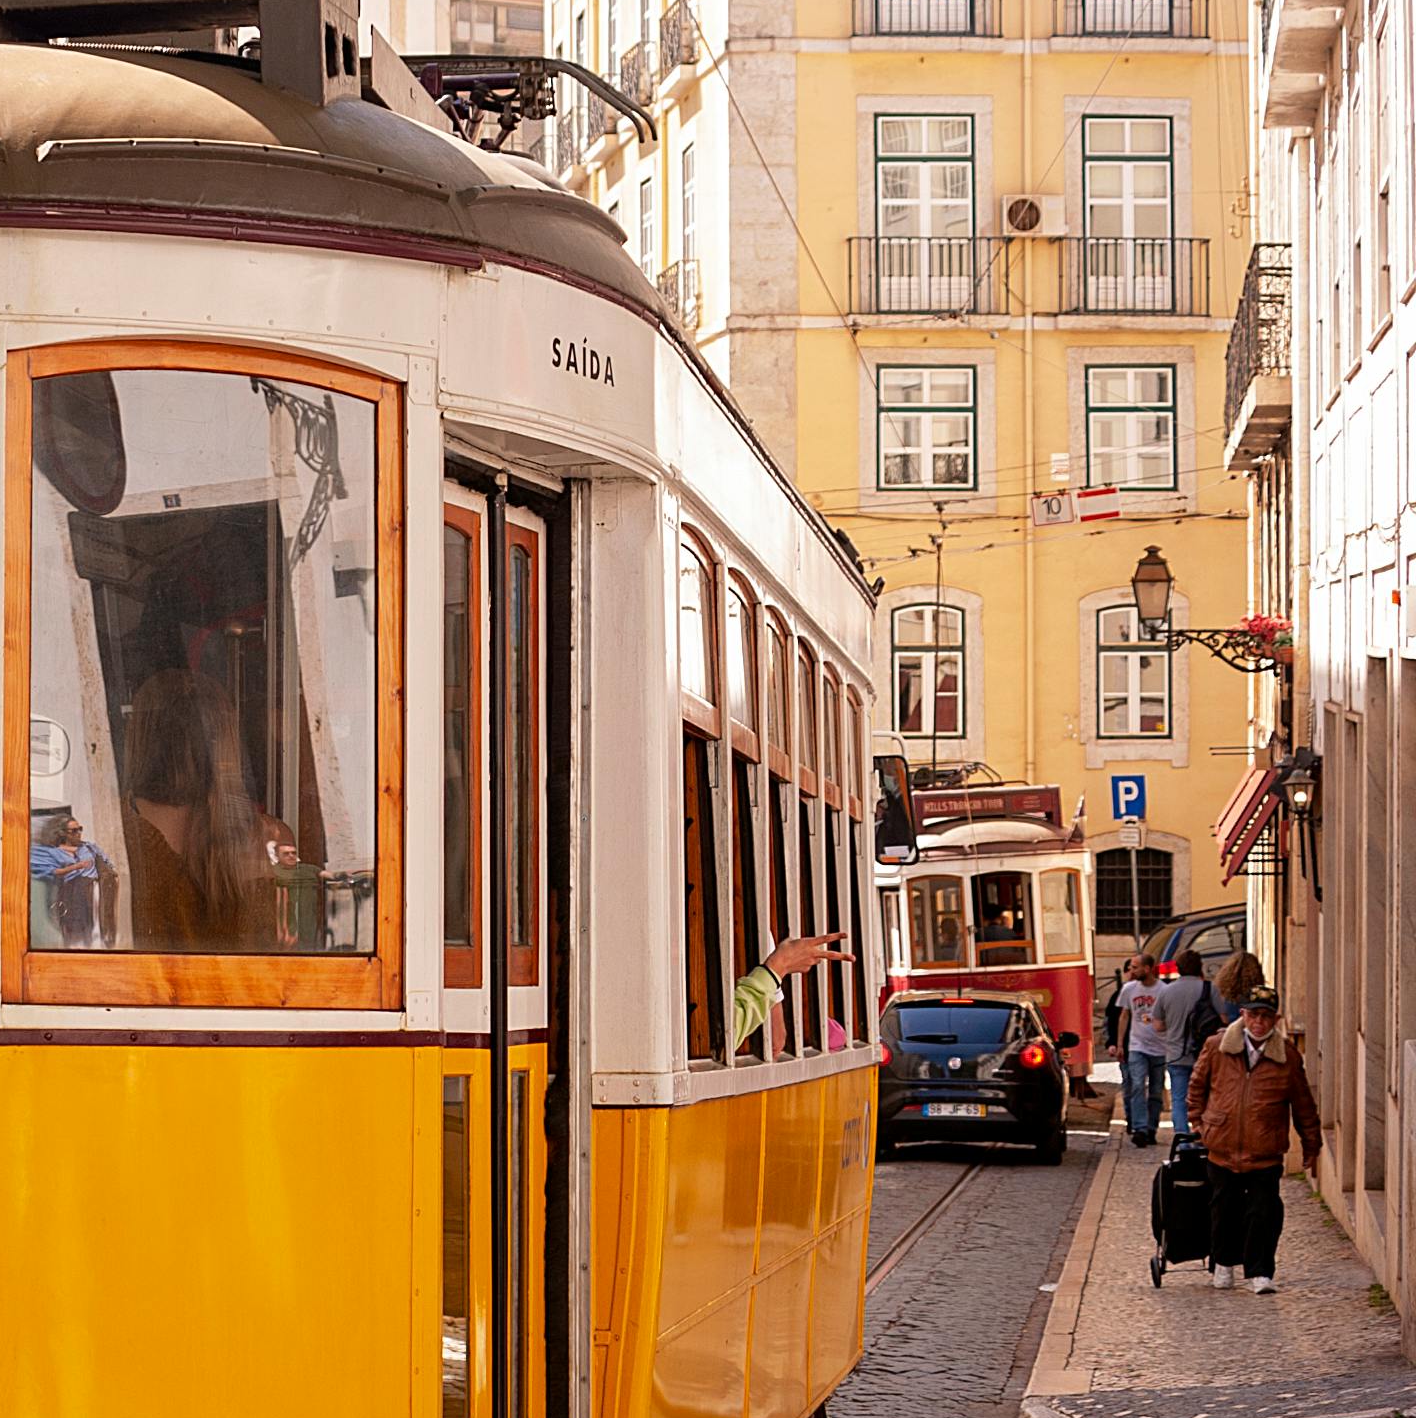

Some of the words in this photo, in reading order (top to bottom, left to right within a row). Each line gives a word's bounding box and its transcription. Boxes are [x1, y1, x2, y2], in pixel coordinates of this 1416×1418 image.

[551, 336, 615, 388] SAÍDA
[1042, 496, 1062, 515] 10
[1118, 780, 1139, 814] P
